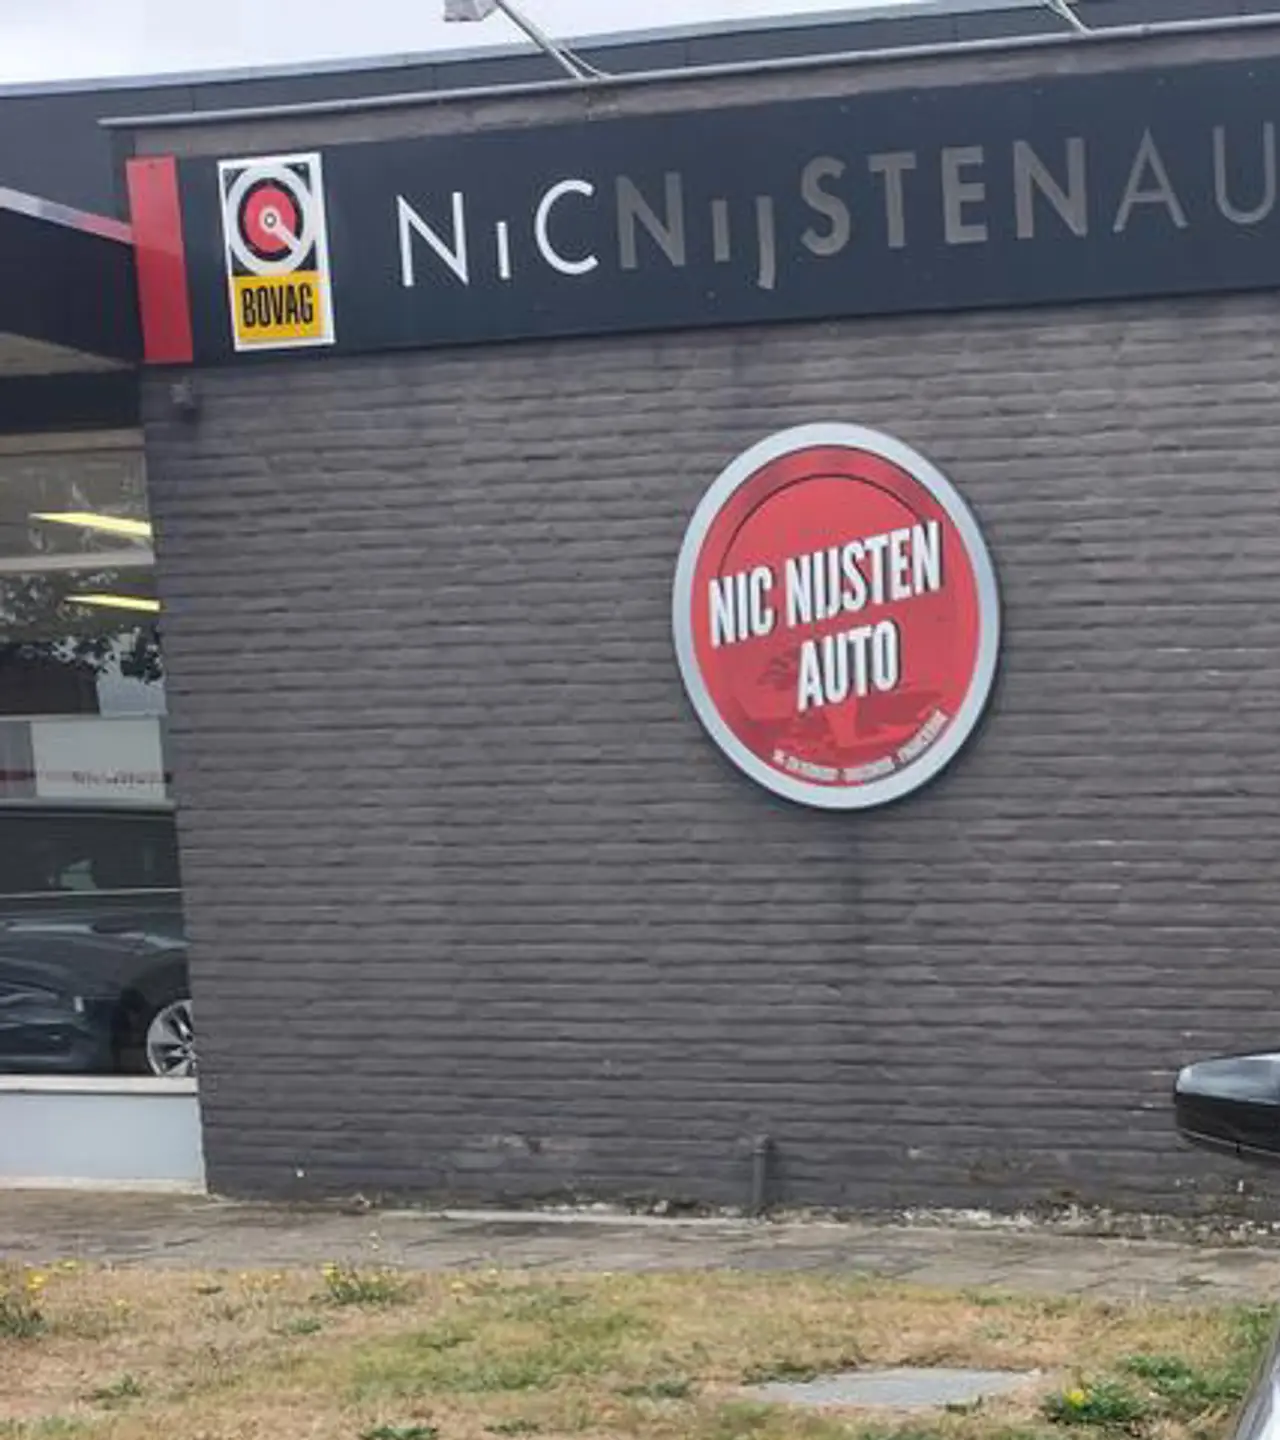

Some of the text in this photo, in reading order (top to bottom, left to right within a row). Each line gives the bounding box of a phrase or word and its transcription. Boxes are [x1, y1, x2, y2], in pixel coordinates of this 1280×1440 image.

[241, 281, 315, 330] BOVAG
[708, 520, 941, 649] NIC NIJSTEN
[797, 619, 901, 712] AUTO
